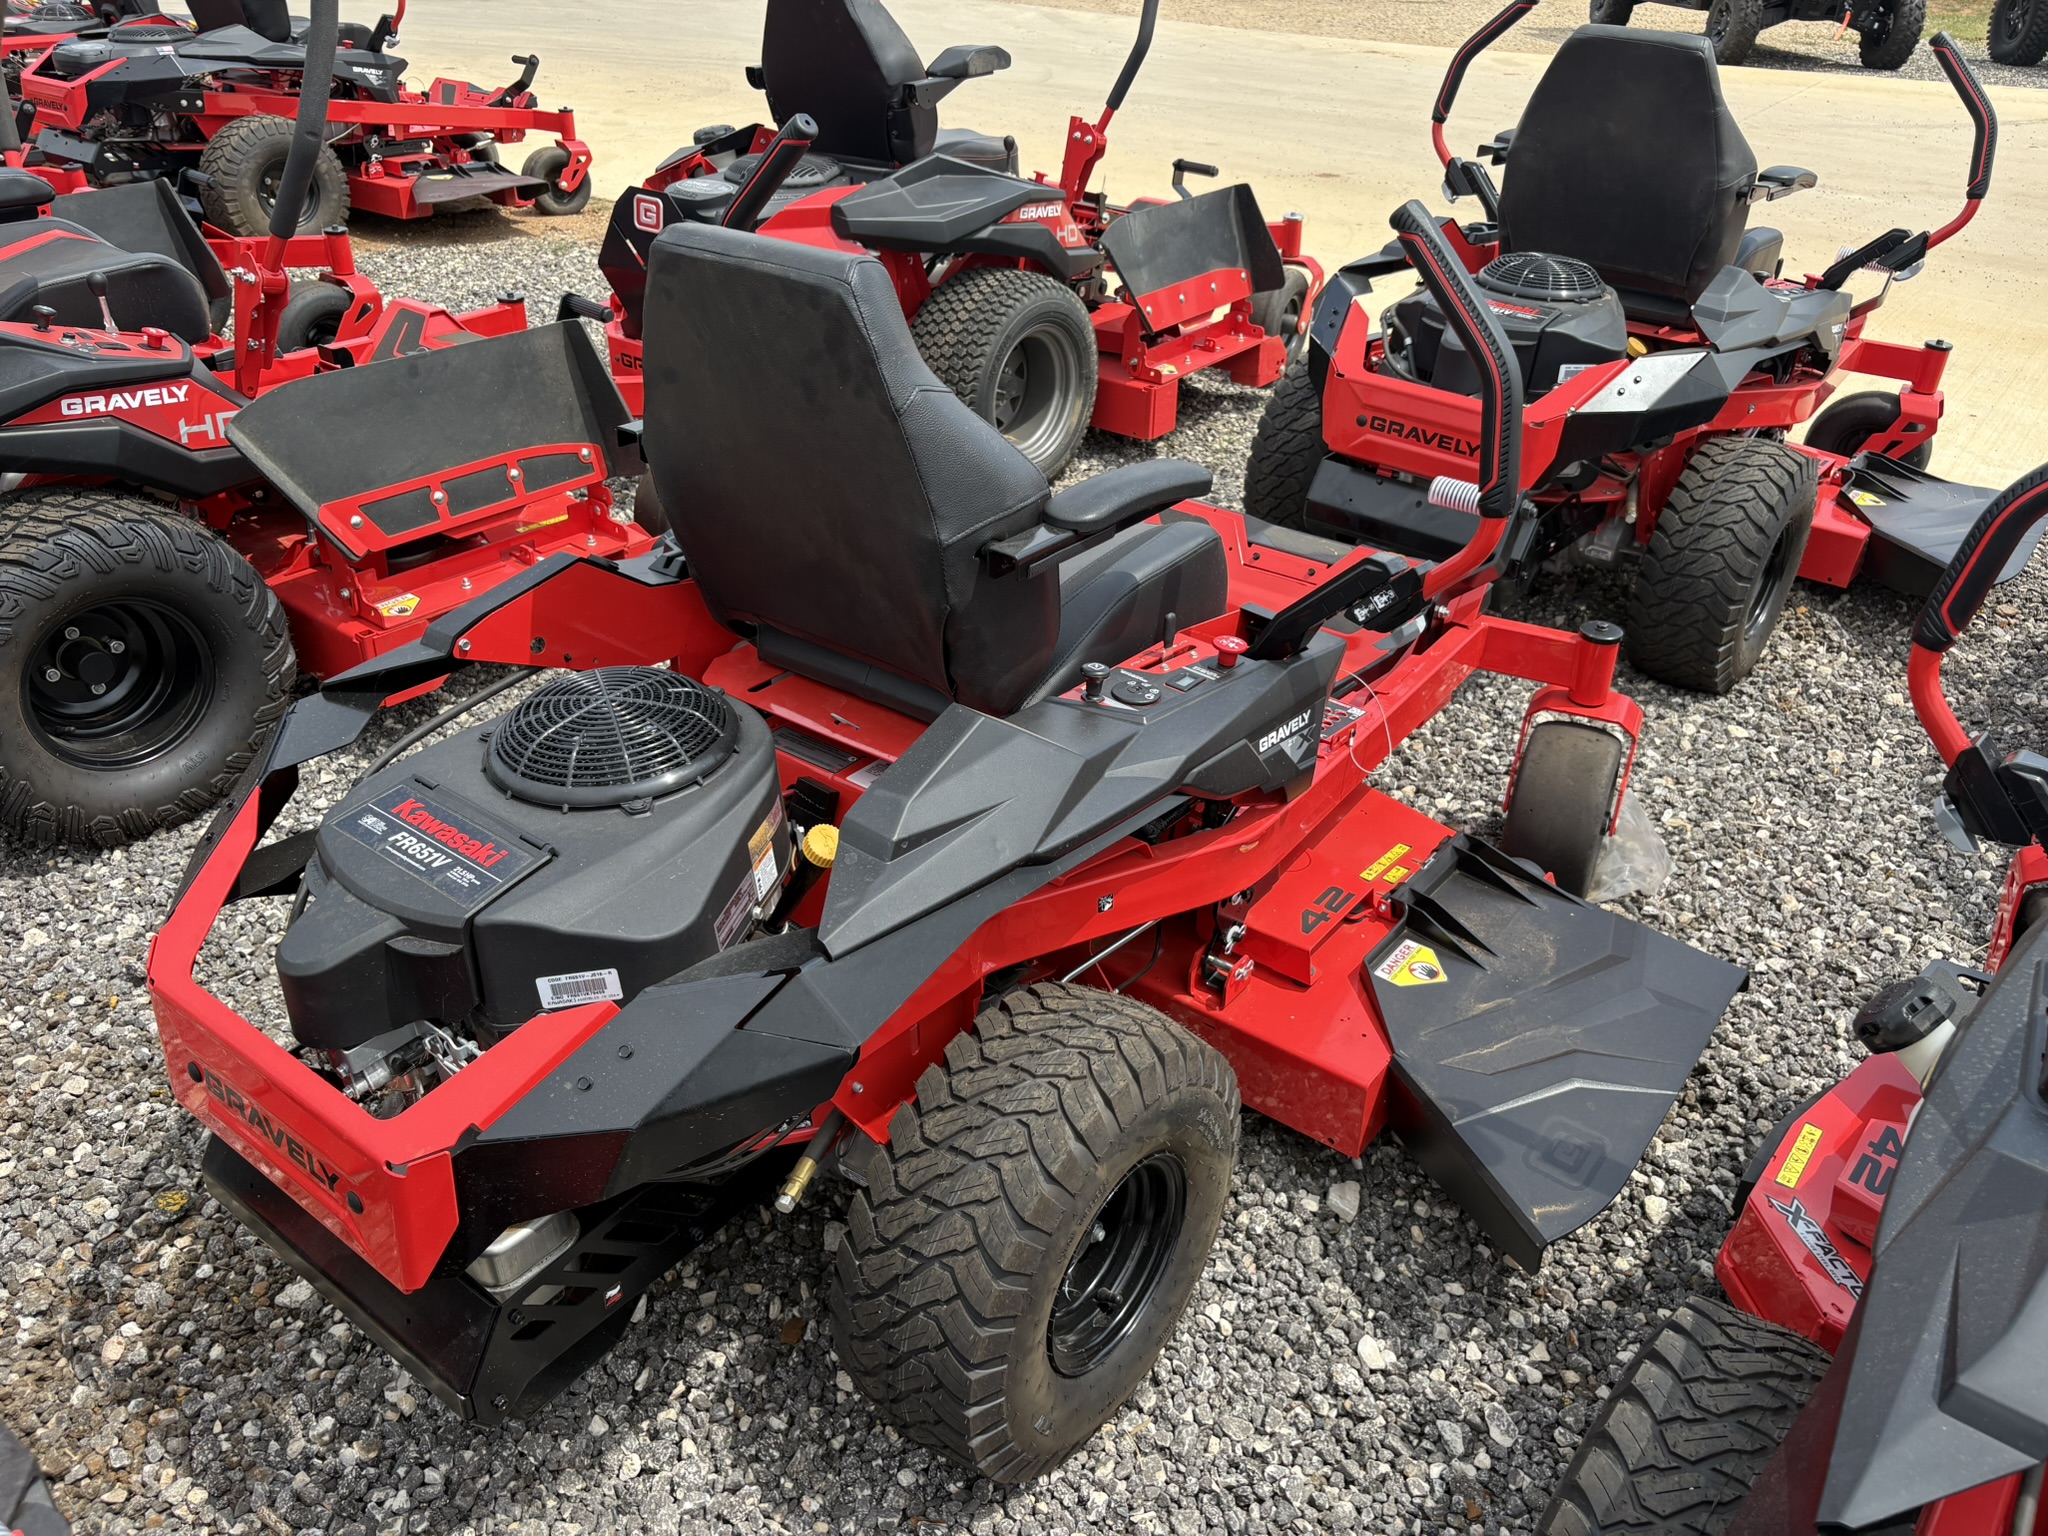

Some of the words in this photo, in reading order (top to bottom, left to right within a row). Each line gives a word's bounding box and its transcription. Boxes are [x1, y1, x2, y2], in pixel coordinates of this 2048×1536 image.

[352, 66, 384, 75] GRAVELY
[33, 97, 64, 112] GRAVELY
[1020, 204, 1063, 219] GRAVELY
[1057, 224, 1079, 243] HD
[61, 384, 190, 416] GRAVELY
[1369, 415, 1481, 458] GRAVELY
[1259, 708, 1312, 753] GRAVELY
[388, 831, 453, 869] FR651V
[390, 798, 509, 868] Kawasaki
[1301, 886, 1356, 935] 42
[1380, 944, 1415, 975] DANGER
[203, 1067, 341, 1193] GRAVELY
[1848, 1125, 1903, 1196] 42
